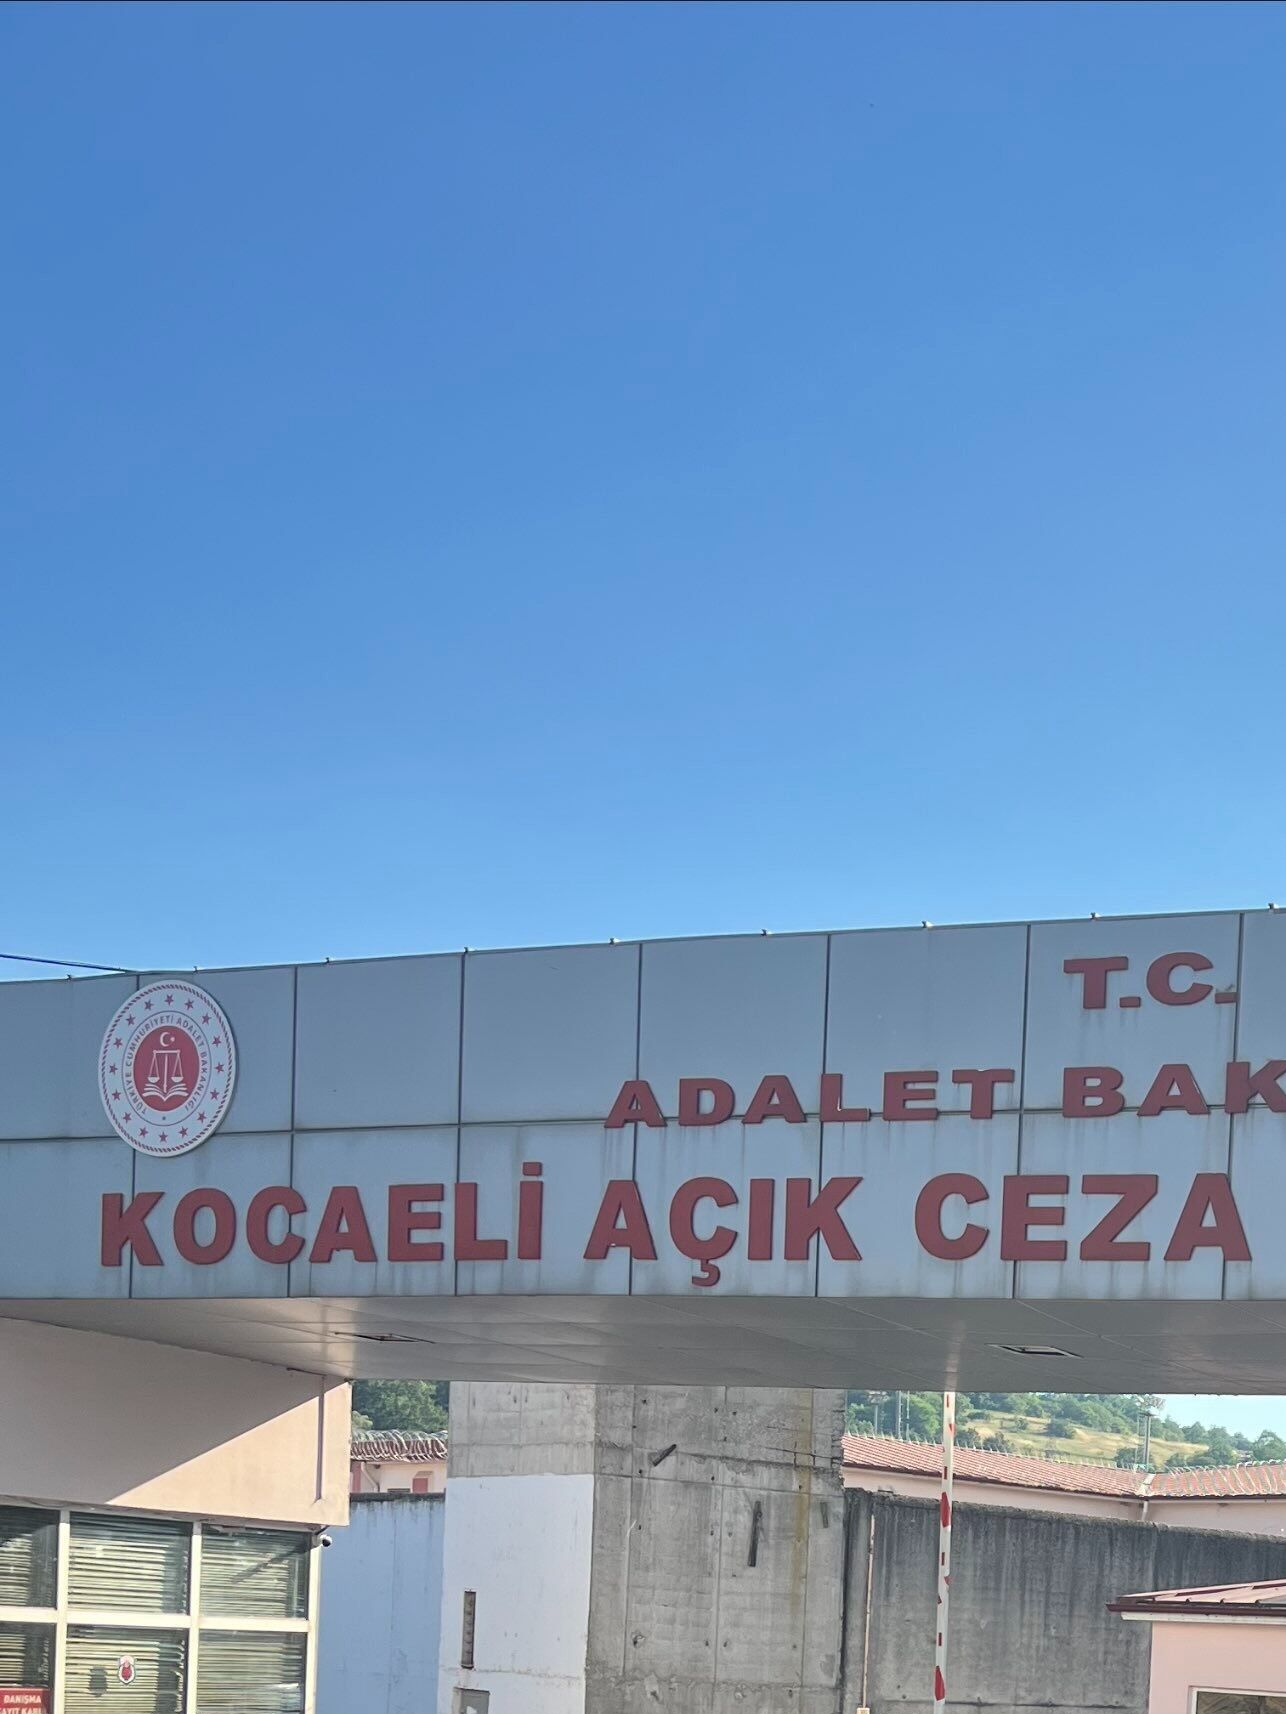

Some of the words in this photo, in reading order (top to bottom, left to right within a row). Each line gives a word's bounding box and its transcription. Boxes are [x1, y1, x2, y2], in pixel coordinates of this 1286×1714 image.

[1064, 952, 1238, 1010] T.C.
[126, 1015, 175, 1067] CUMHURİYETİ
[176, 1017, 205, 1046] ADALET
[125, 1071, 148, 1115] TÜRKİYE
[604, 1068, 1015, 1128] ADALET
[101, 1162, 544, 1267] KOCAELİ
[583, 1177, 863, 1286] AÇIK
[914, 1172, 1252, 1262] CEZA
